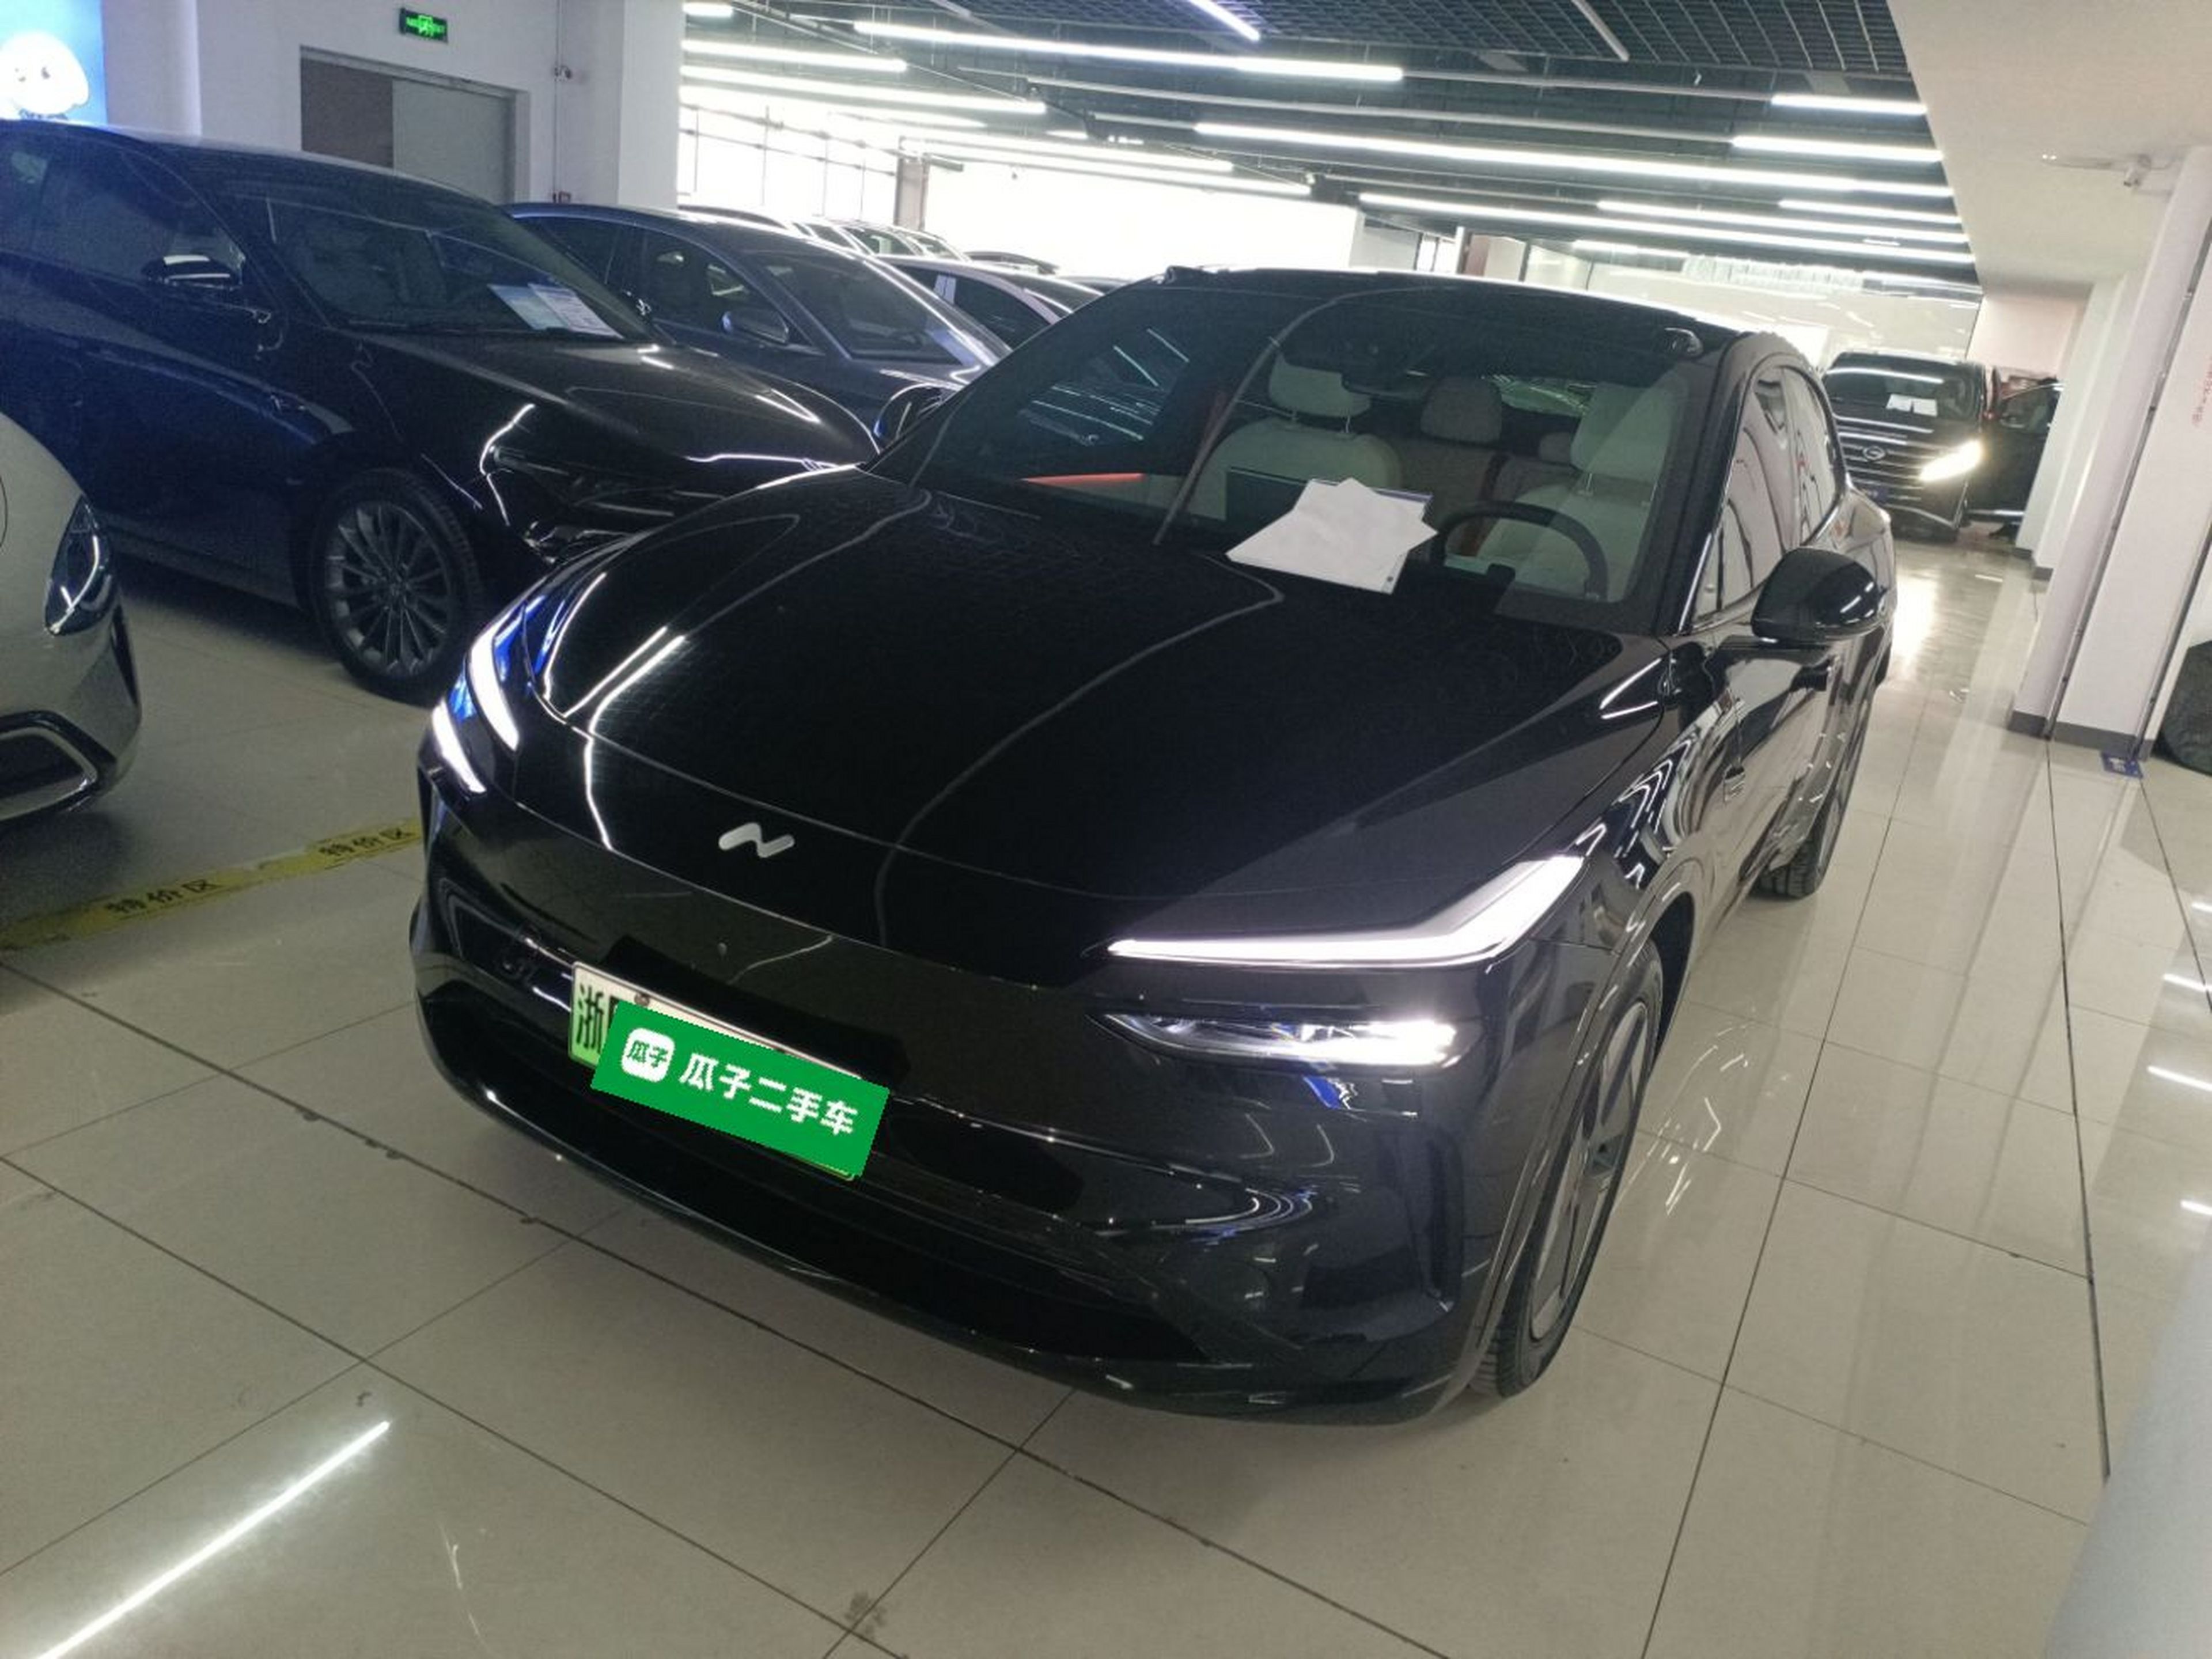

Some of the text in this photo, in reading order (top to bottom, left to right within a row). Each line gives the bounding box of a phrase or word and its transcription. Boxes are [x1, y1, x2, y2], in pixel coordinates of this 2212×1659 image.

[320, 827, 414, 858] 特价区
[105, 879, 221, 914] 特价区
[577, 983, 619, 1055] 浙
